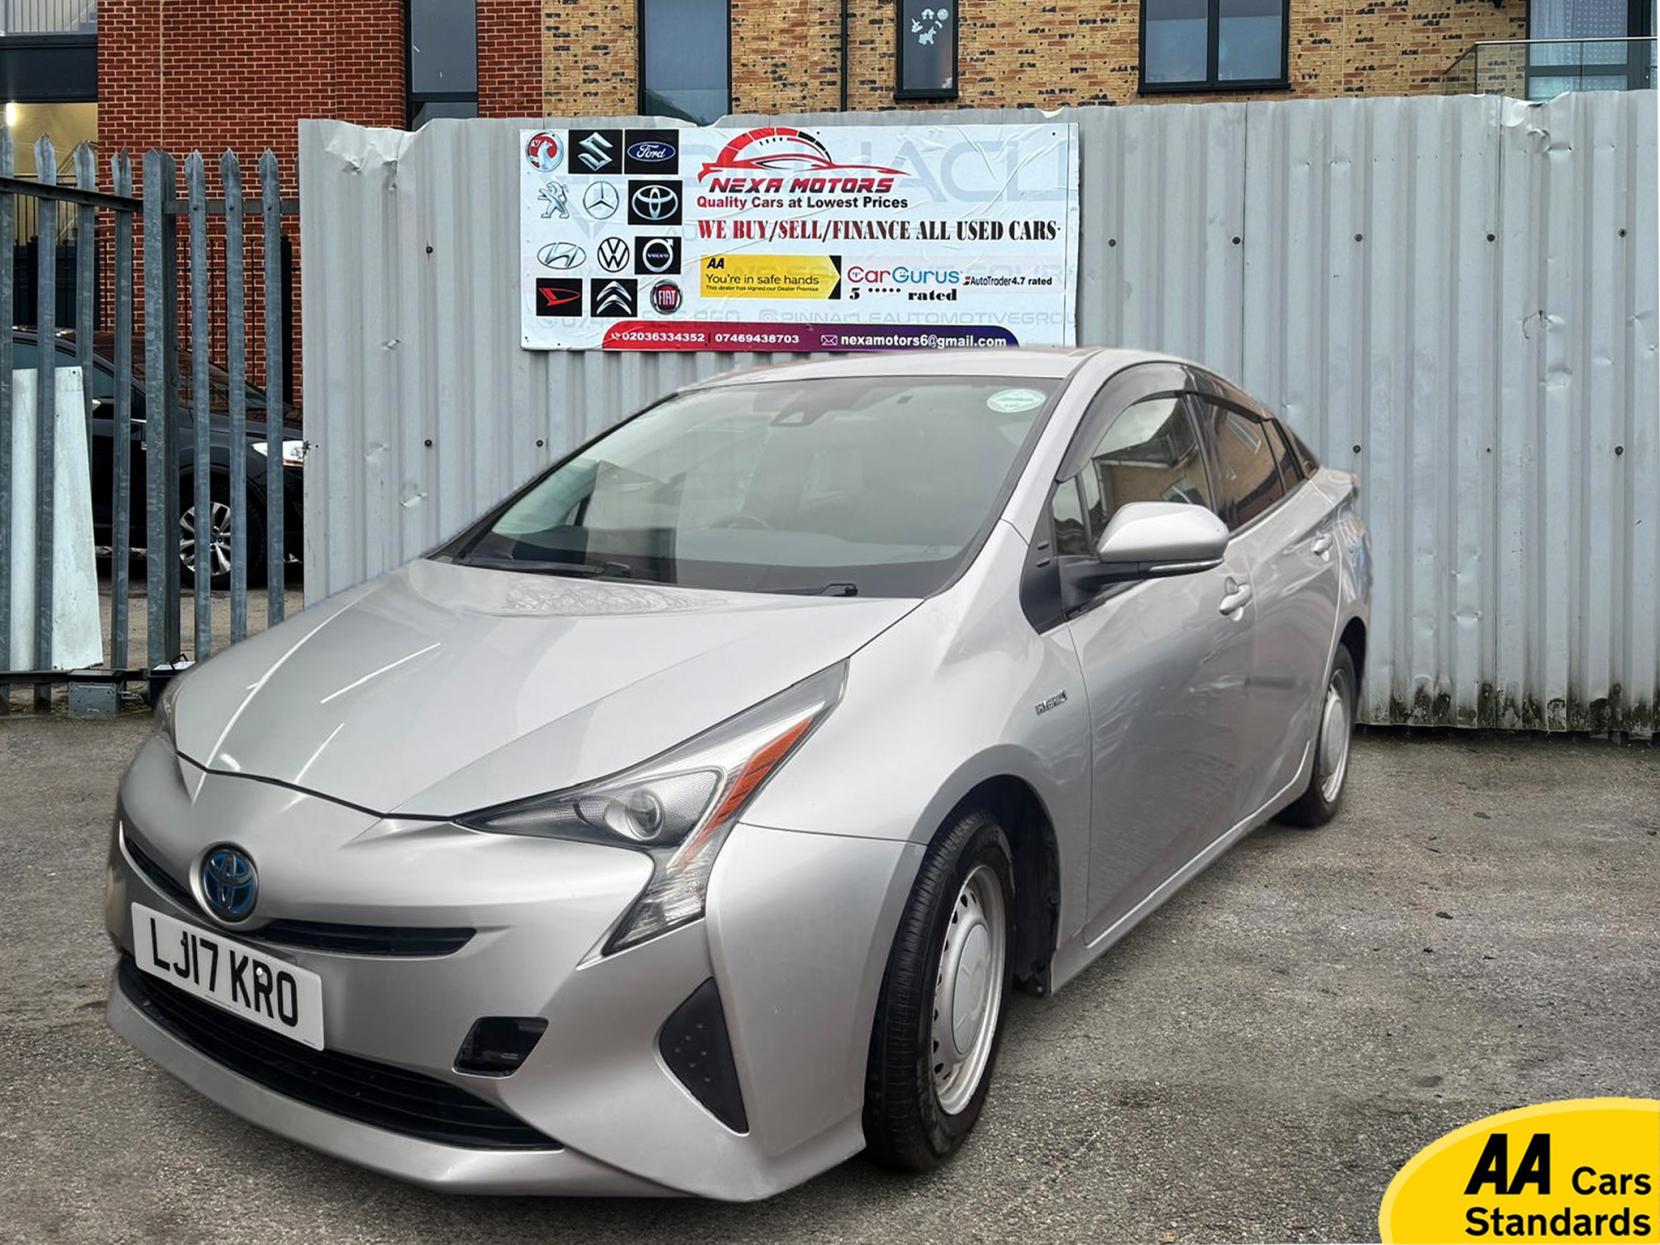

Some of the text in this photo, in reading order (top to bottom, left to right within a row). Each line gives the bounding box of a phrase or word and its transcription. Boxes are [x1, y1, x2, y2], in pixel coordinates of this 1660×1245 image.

[636, 144, 666, 159] Ford
[708, 177, 895, 194] NEXA MOTORS
[697, 195, 908, 211] Quality Cars at Lowest Prices
[697, 219, 727, 240] WE
[916, 220, 951, 241] ALL
[956, 220, 1003, 241] USED
[1008, 220, 1057, 241] CARS
[706, 257, 725, 269] AA
[705, 274, 819, 285] You're in safe hands
[847, 265, 960, 284] CarGurus
[1028, 276, 1053, 286] rated
[658, 290, 677, 306] FIAT
[849, 287, 957, 301] 5 rated
[621, 332, 800, 344] 02036334352 07469438703
[840, 333, 1007, 349] nexamotors6@gmail.com
[149, 917, 299, 1028] LJ17 KRO
